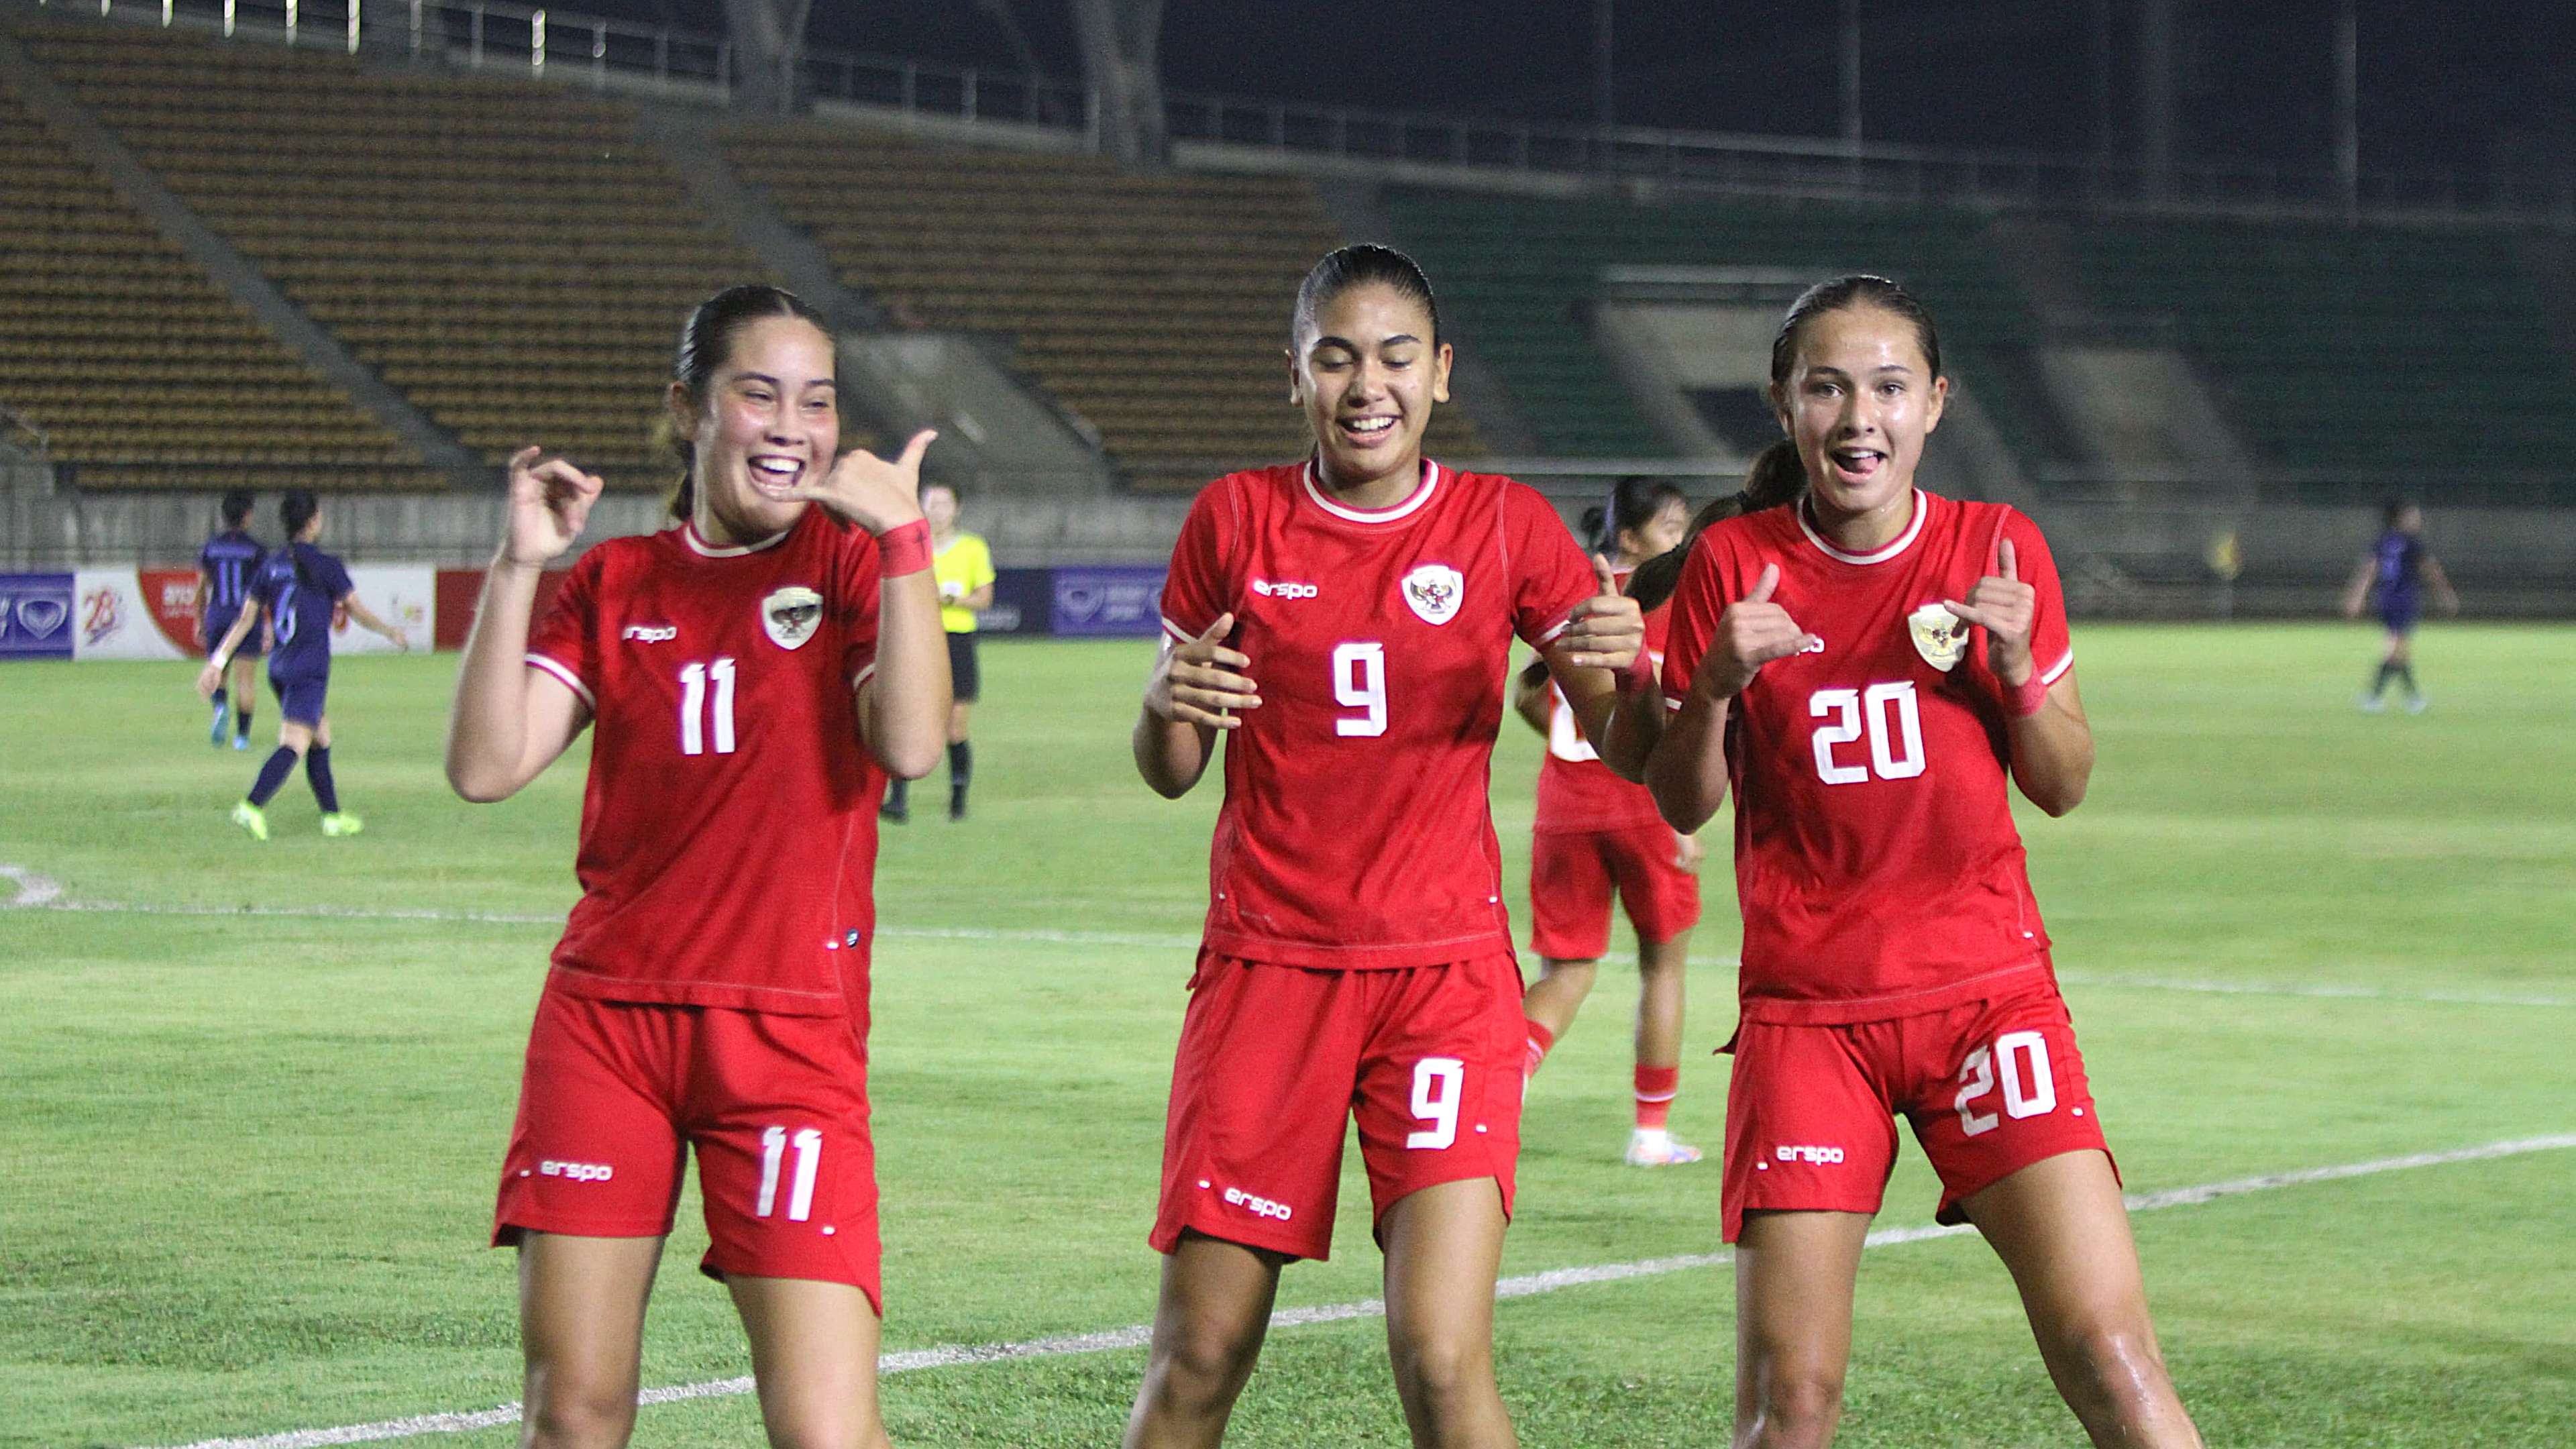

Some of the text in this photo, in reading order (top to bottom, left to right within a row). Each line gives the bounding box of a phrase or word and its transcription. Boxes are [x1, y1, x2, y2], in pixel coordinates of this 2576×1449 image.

[218, 559, 243, 607] 11
[274, 582, 297, 645] 6
[1252, 579, 1318, 600] erspo
[622, 625, 678, 644] rspo
[680, 658, 736, 755] 11
[1334, 642, 1387, 737] 9
[1809, 680, 1927, 785] 20
[1406, 1057, 1464, 1150] 9
[1954, 1030, 2057, 1137] 20
[541, 1160, 613, 1182] erspo
[757, 1126, 822, 1221] 11
[1776, 1145, 1845, 1166] erspo
[1224, 1187, 1292, 1221] erspo
